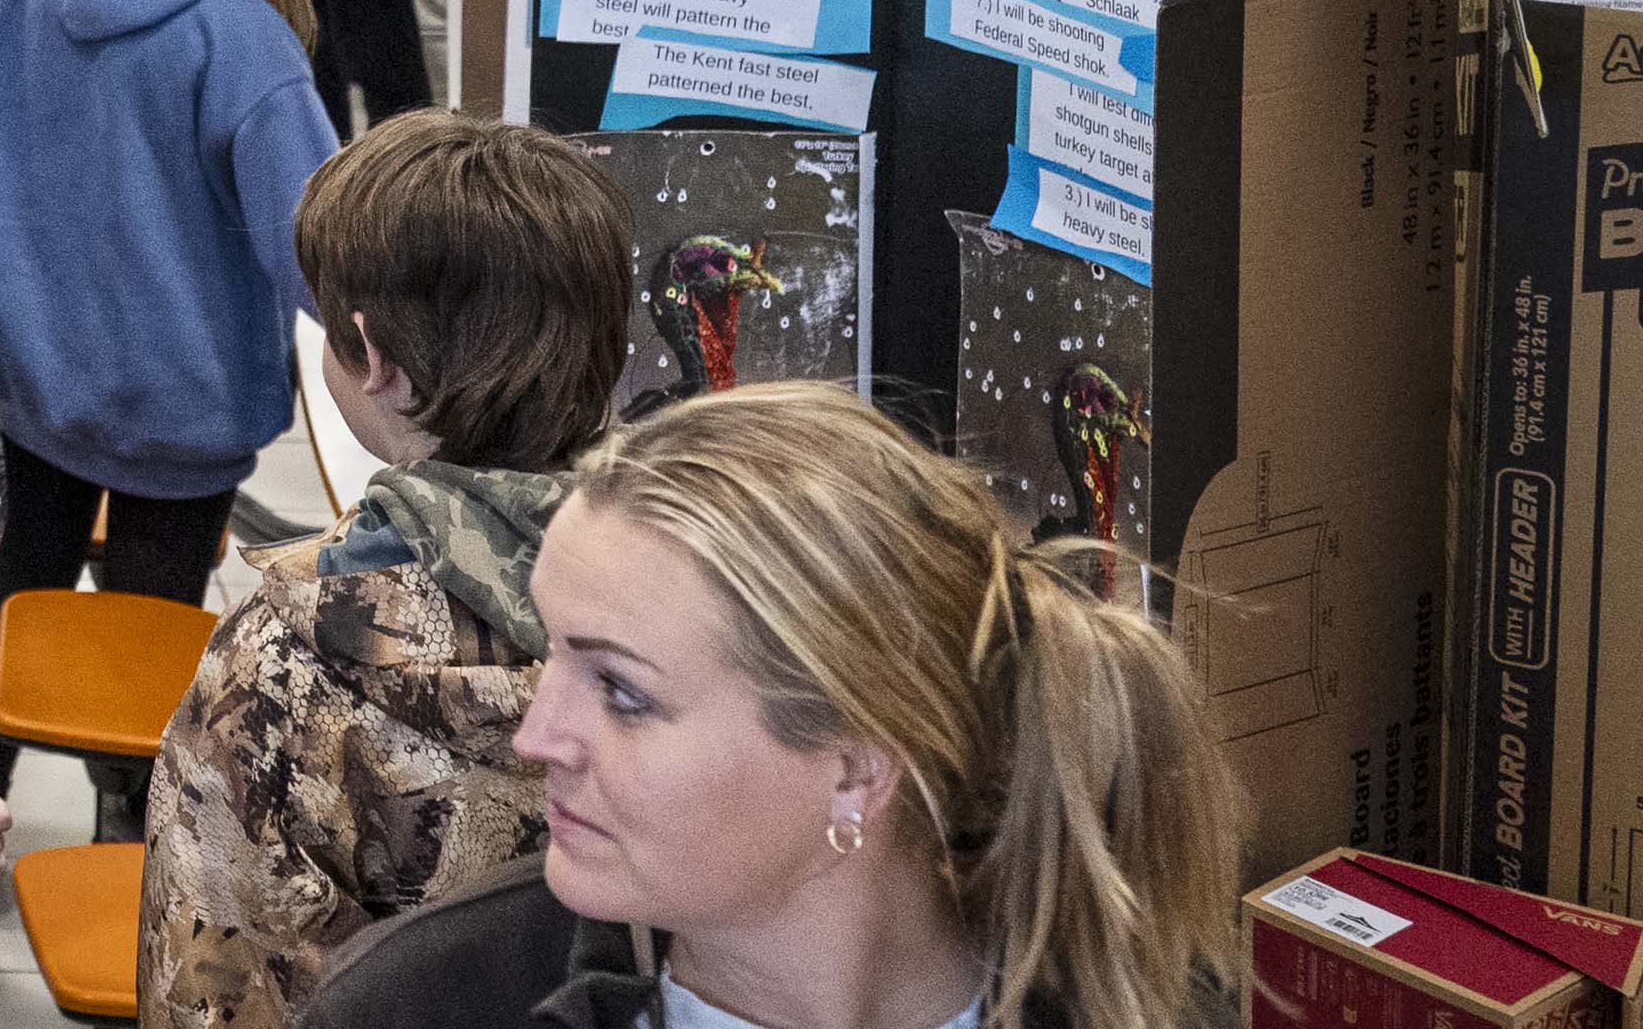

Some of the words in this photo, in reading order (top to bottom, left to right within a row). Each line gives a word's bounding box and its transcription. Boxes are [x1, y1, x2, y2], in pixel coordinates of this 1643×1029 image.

[643, 2, 671, 18] will
[675, 8, 737, 28] pattern
[743, 15, 770, 33] the
[996, 0, 999, 14] I
[1003, 4, 1024, 21] will
[1028, 8, 1044, 28] be
[1048, 17, 1104, 50] shooting
[1365, 11, 1377, 51] Noir
[654, 44, 686, 63] The
[692, 51, 733, 70] Kent
[738, 57, 771, 76] fast
[776, 66, 819, 83] steel
[975, 19, 1023, 48] Federal
[1027, 36, 1070, 64] Speed
[1074, 52, 1109, 77] shok.
[647, 73, 732, 96] patterned
[737, 84, 765, 101] the
[1363, 74, 1379, 133] Negro
[1056, 106, 1109, 138] shotgun
[1113, 128, 1156, 158] shells
[1054, 132, 1095, 163] turkey
[1099, 150, 1138, 178] target
[1361, 155, 1375, 207] Black
[1062, 210, 1105, 243] heavy
[1108, 231, 1144, 256] steel.
[1515, 275, 1532, 293] in.
[1515, 297, 1531, 318] 48
[1518, 322, 1529, 331] x
[1533, 294, 1551, 323] cm)
[1513, 335, 1529, 353] in.
[1531, 329, 1547, 356] 121
[1513, 358, 1528, 377] 36
[1533, 375, 1545, 397] cm
[1535, 362, 1546, 372] x
[1513, 382, 1527, 402] to:
[1510, 405, 1529, 456] Opens
[1527, 400, 1546, 442] (91.4
[1509, 478, 1539, 605] HEADER
[1505, 607, 1524, 656] WITH
[1501, 671, 1529, 730] KIT
[1496, 733, 1528, 852] BOARD
[1542, 904, 1624, 937] VANS
